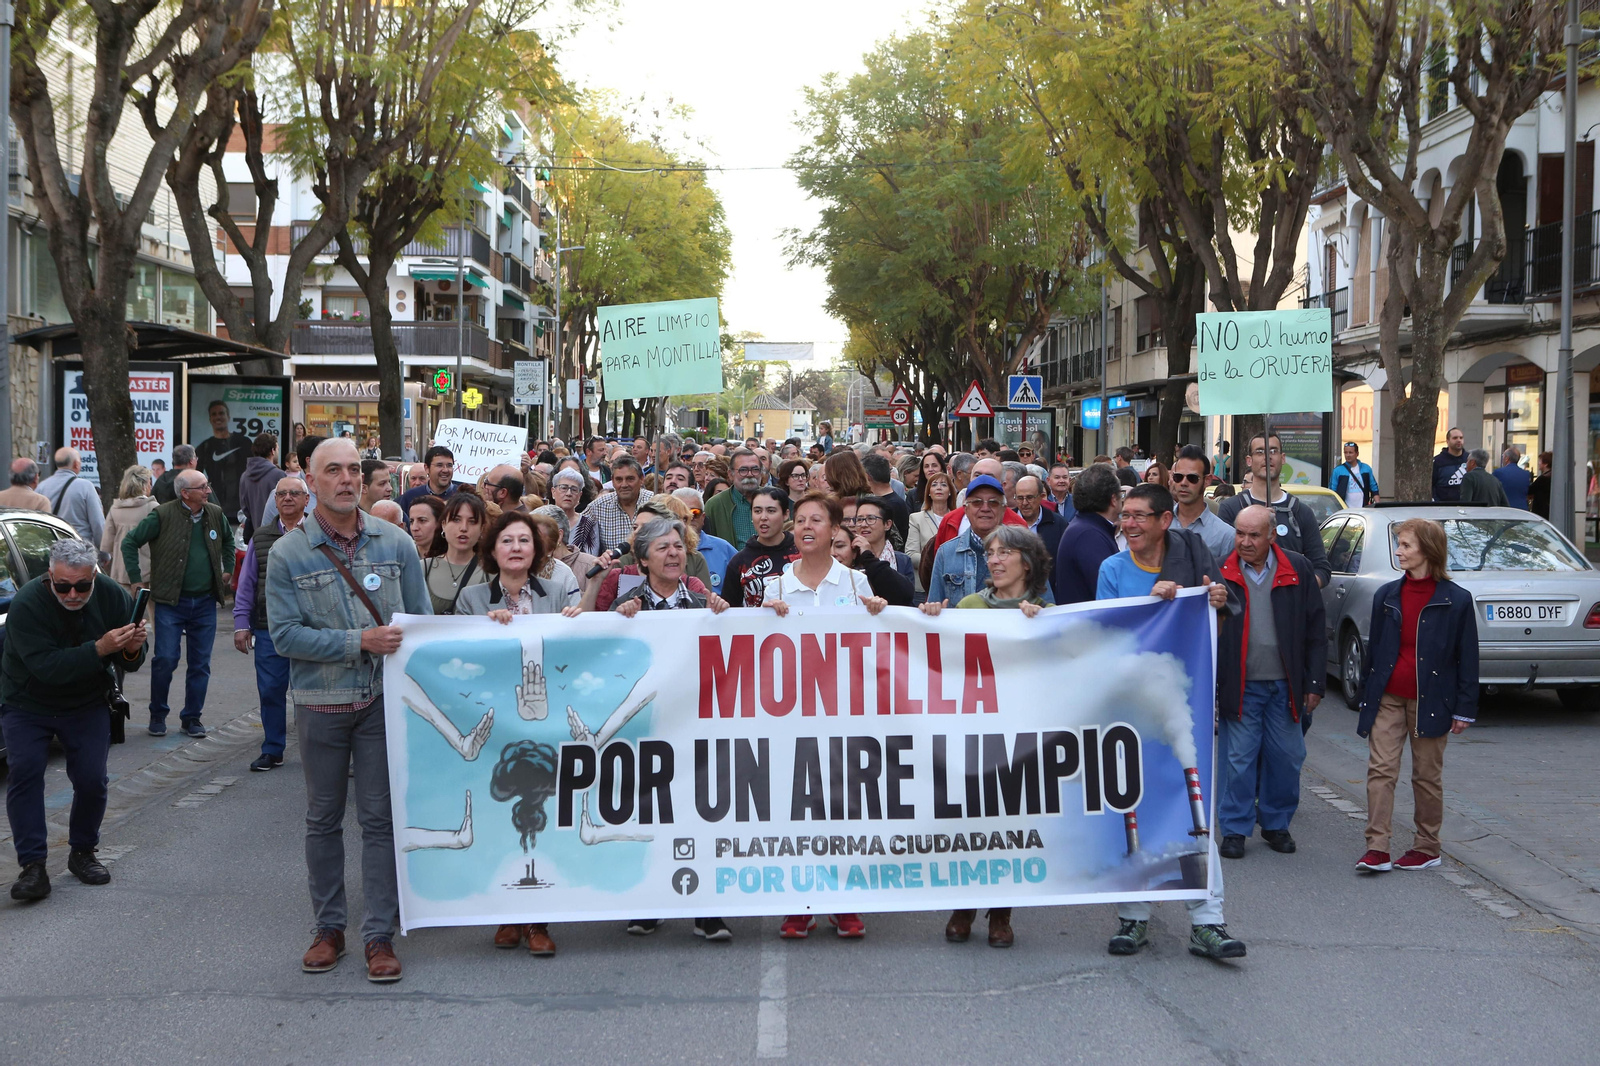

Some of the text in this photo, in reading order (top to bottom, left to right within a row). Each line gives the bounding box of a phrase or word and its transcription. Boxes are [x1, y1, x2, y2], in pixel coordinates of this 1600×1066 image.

[603, 312, 710, 343] AIRE LIMPIO
[1200, 319, 1328, 353] NO al humo
[605, 340, 720, 373] PARA MONTILLA
[1200, 354, 1331, 382] de la ORUJERA
[129, 379, 167, 391] ASTER
[228, 389, 278, 400] Sprinter
[298, 381, 380, 397] FARMAC
[133, 399, 169, 411] NLINE
[71, 411, 81, 422] O
[895, 412, 905, 420] 30
[998, 416, 1048, 425] Manhttan
[135, 428, 165, 440] OUR
[232, 417, 264, 438] 39
[437, 424, 518, 445] POR MONTILLA
[446, 438, 511, 457] SIN HUMOS
[1497, 605, 1563, 619] 6880 DYF
[698, 632, 999, 719] MONTILLA
[557, 724, 1142, 828] POR UN AIRE LIMPIO
[715, 828, 1044, 858] PLATAFORMA CIUDADANA
[715, 856, 1048, 894] POR UN AIRE LIMPIO
